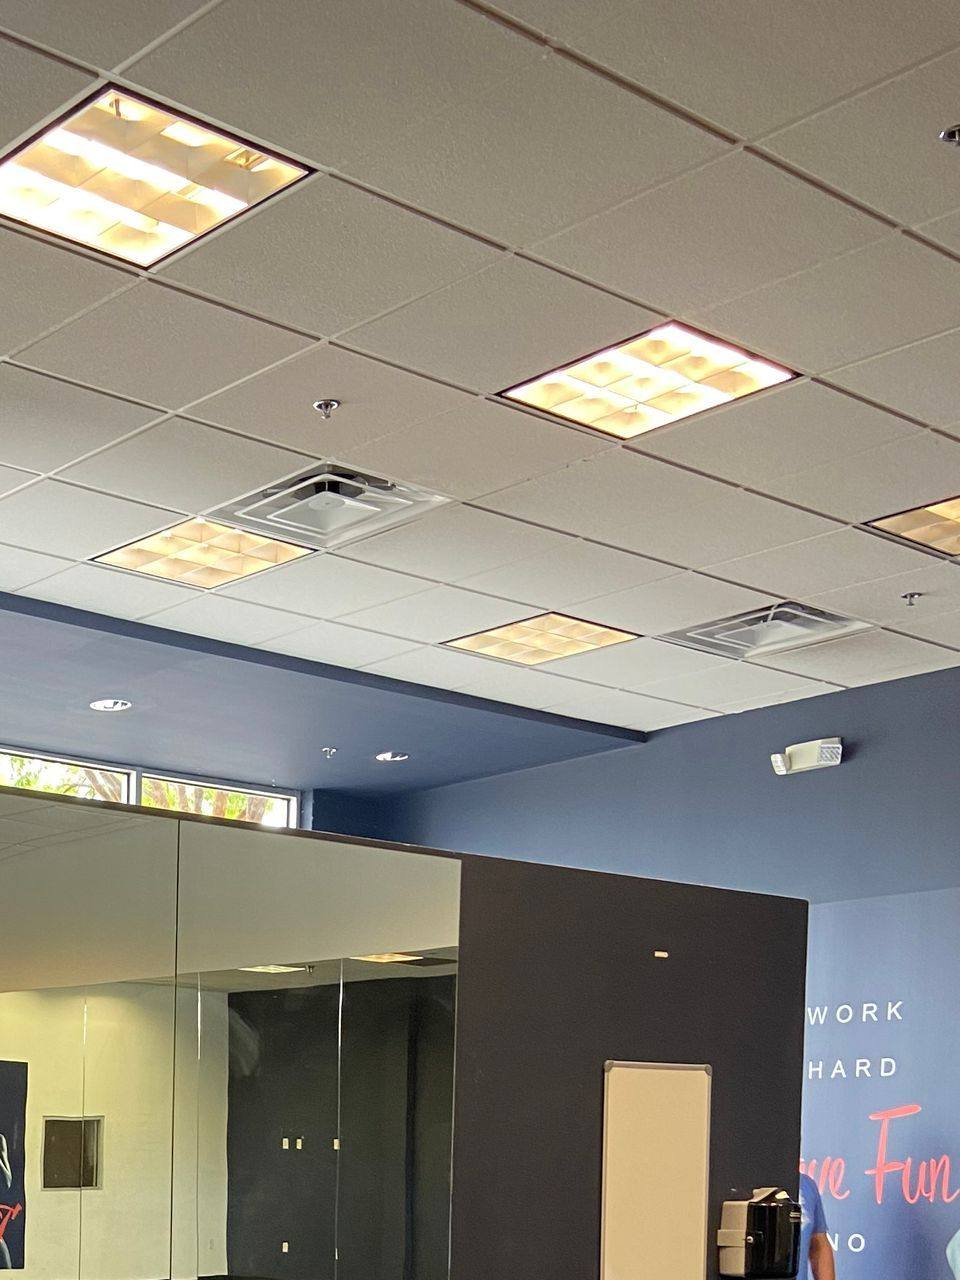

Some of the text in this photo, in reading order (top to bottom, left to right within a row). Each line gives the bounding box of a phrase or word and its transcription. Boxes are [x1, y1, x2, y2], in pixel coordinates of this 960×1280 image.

[807, 1001, 903, 1025] WORK
[808, 1057, 896, 1080] HARD
[864, 1104, 960, 1205] Fun
